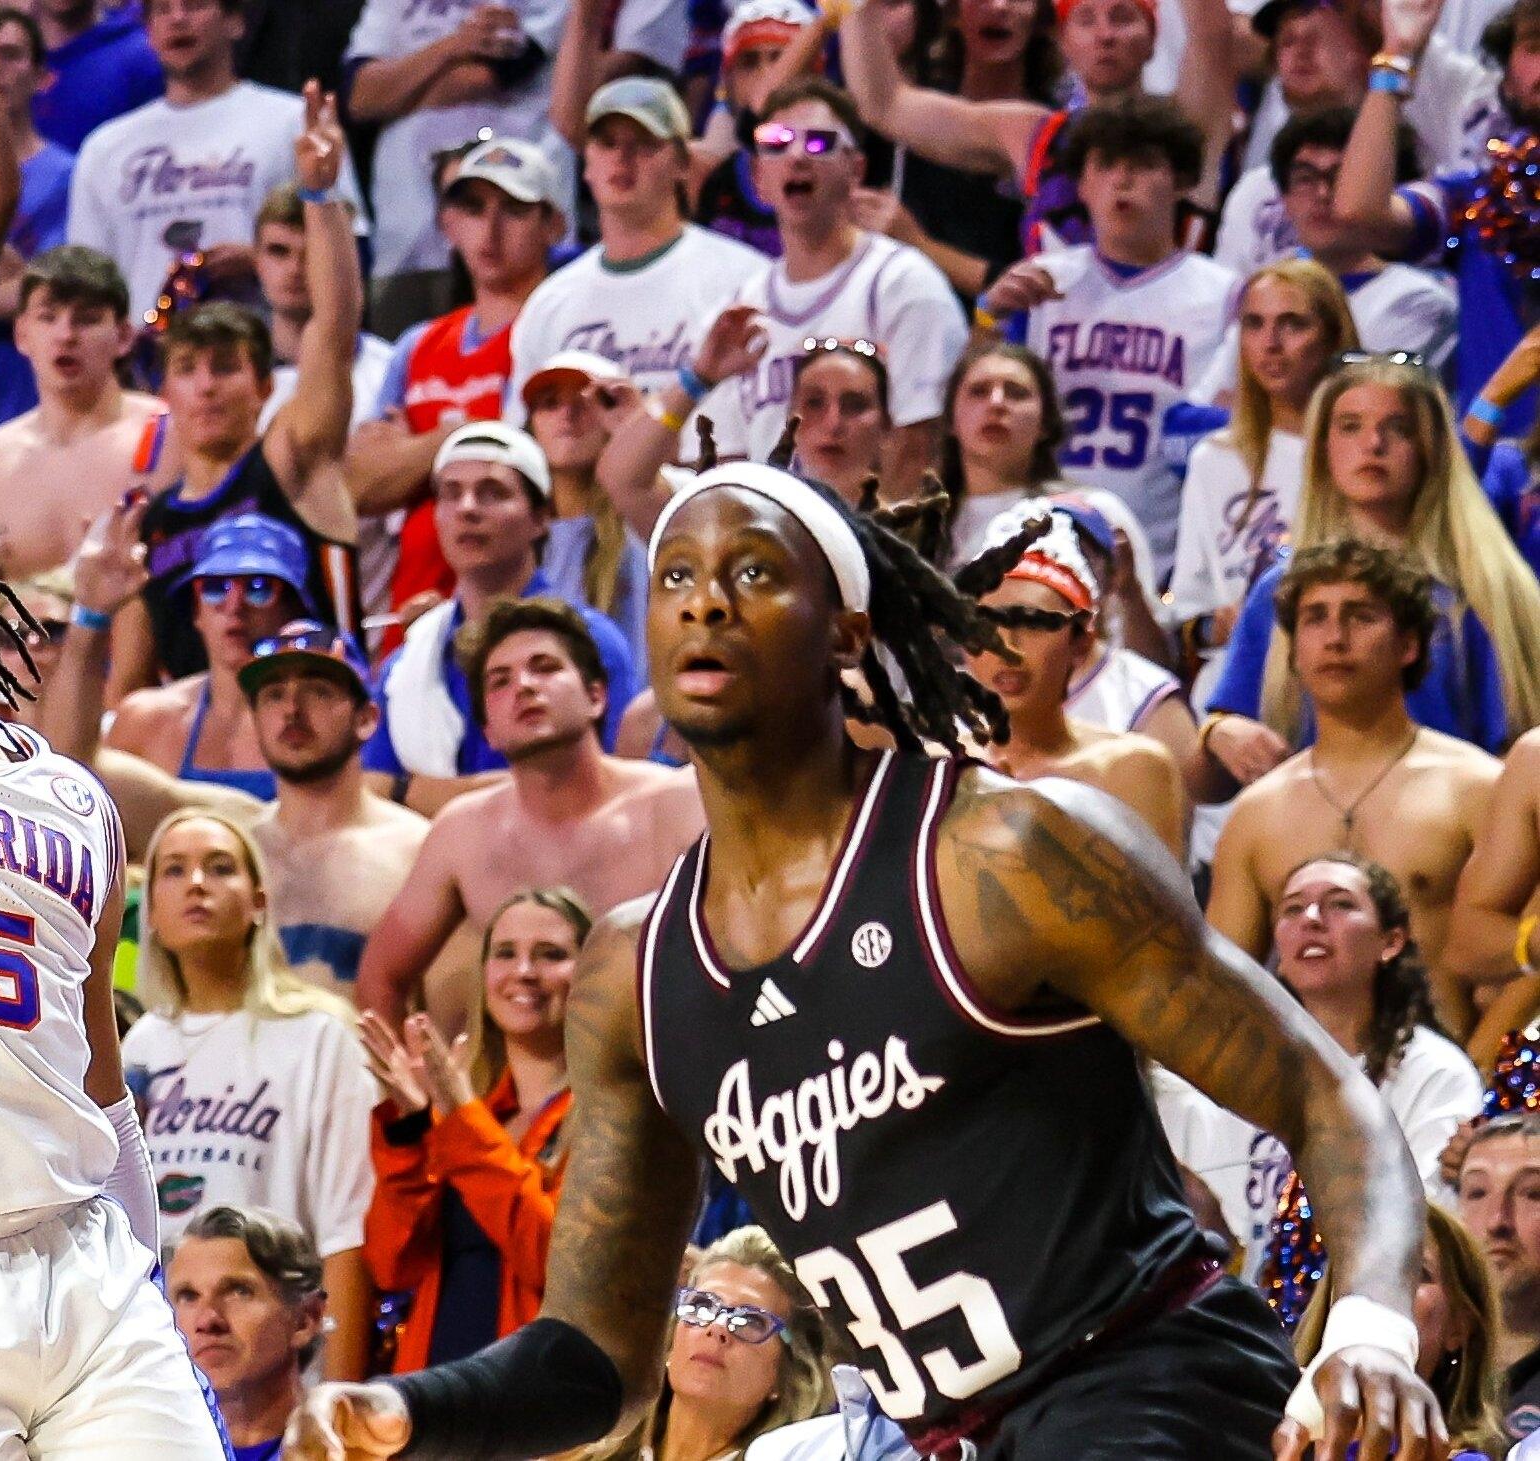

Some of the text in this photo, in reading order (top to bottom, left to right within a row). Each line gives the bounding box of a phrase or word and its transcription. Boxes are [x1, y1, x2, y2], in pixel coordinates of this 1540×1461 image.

[1048, 322, 1184, 388] FLORIDA
[1058, 387, 1154, 470] 25
[705, 1035, 947, 1222] Aggies
[795, 1200, 1022, 1419] 35
